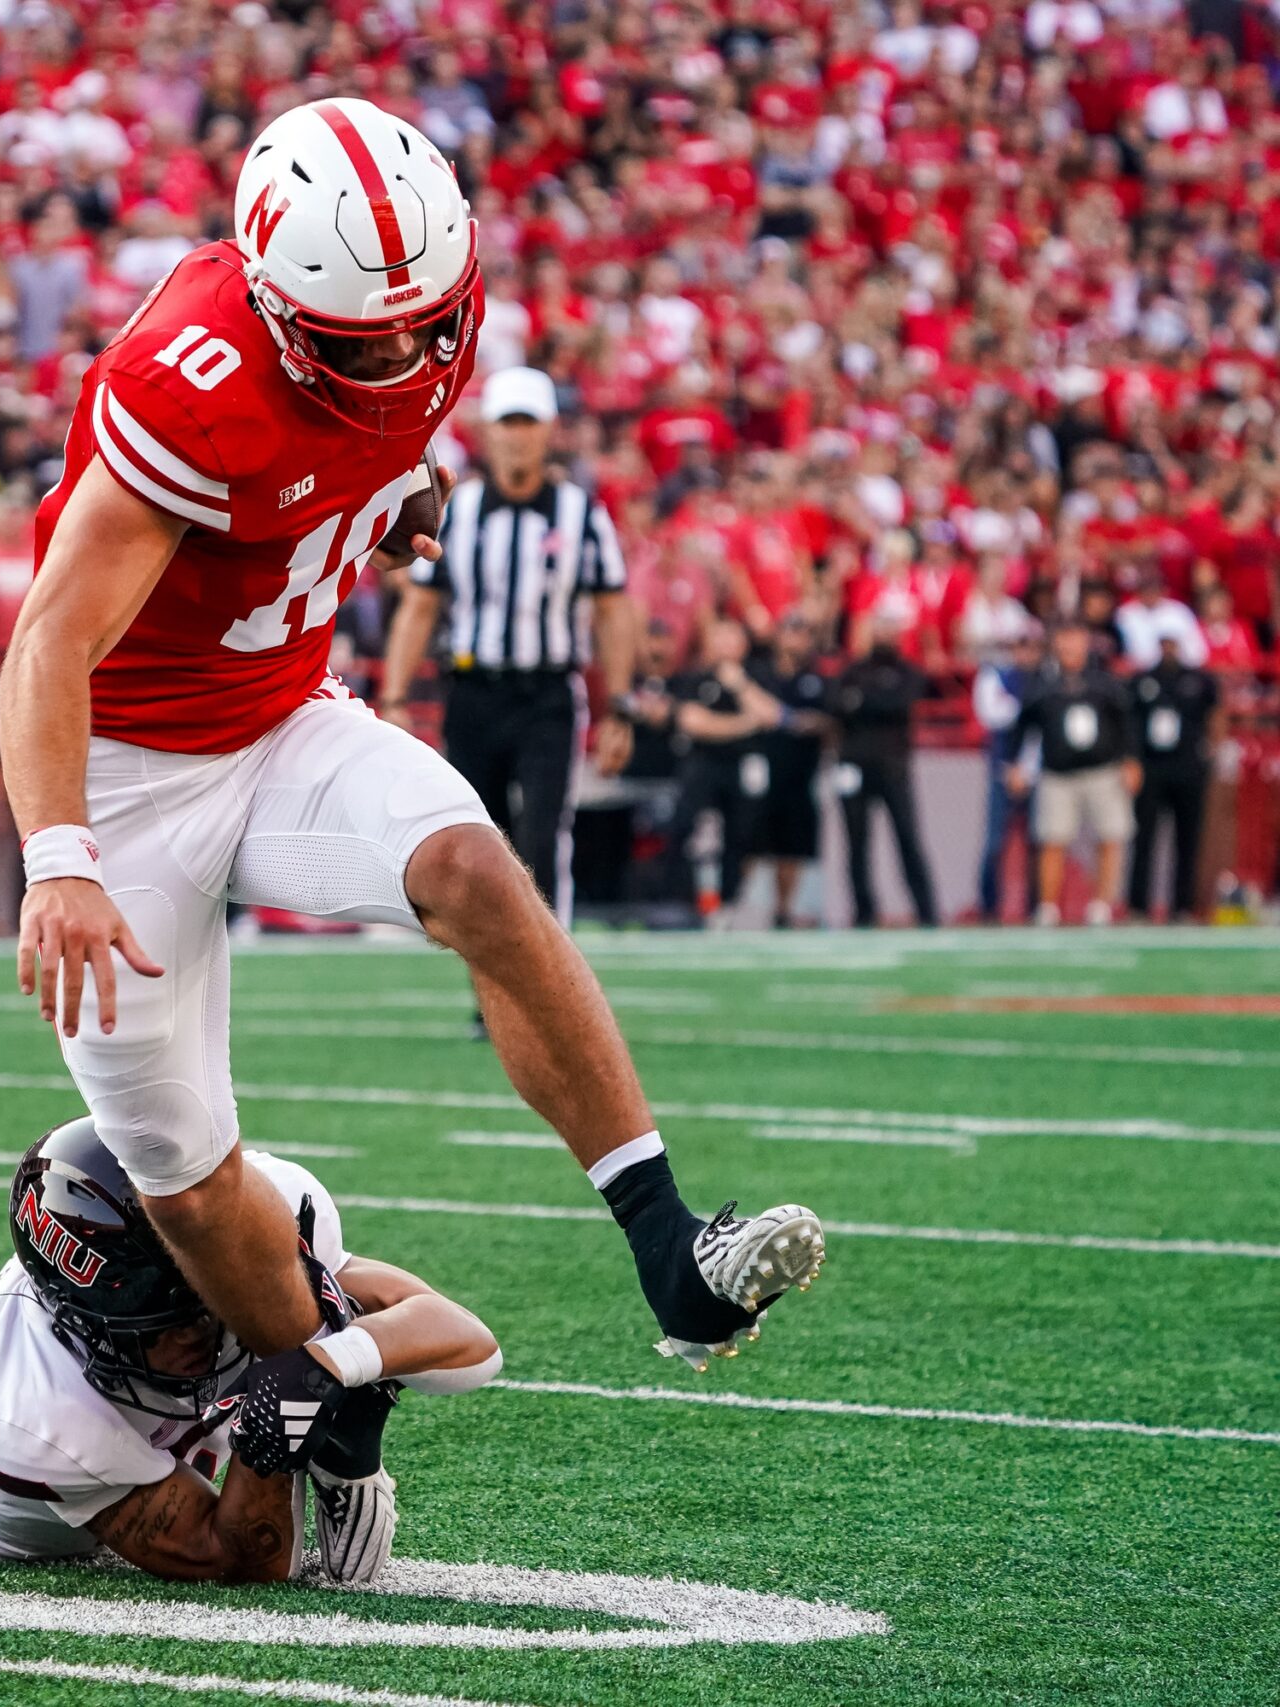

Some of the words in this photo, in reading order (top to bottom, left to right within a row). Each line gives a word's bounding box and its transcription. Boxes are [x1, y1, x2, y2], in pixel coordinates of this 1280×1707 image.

[244, 178, 292, 258] N
[383, 285, 424, 307] HUSKERS
[152, 324, 243, 392] 10
[219, 469, 414, 652] 10
[15, 1183, 108, 1288] NIU
